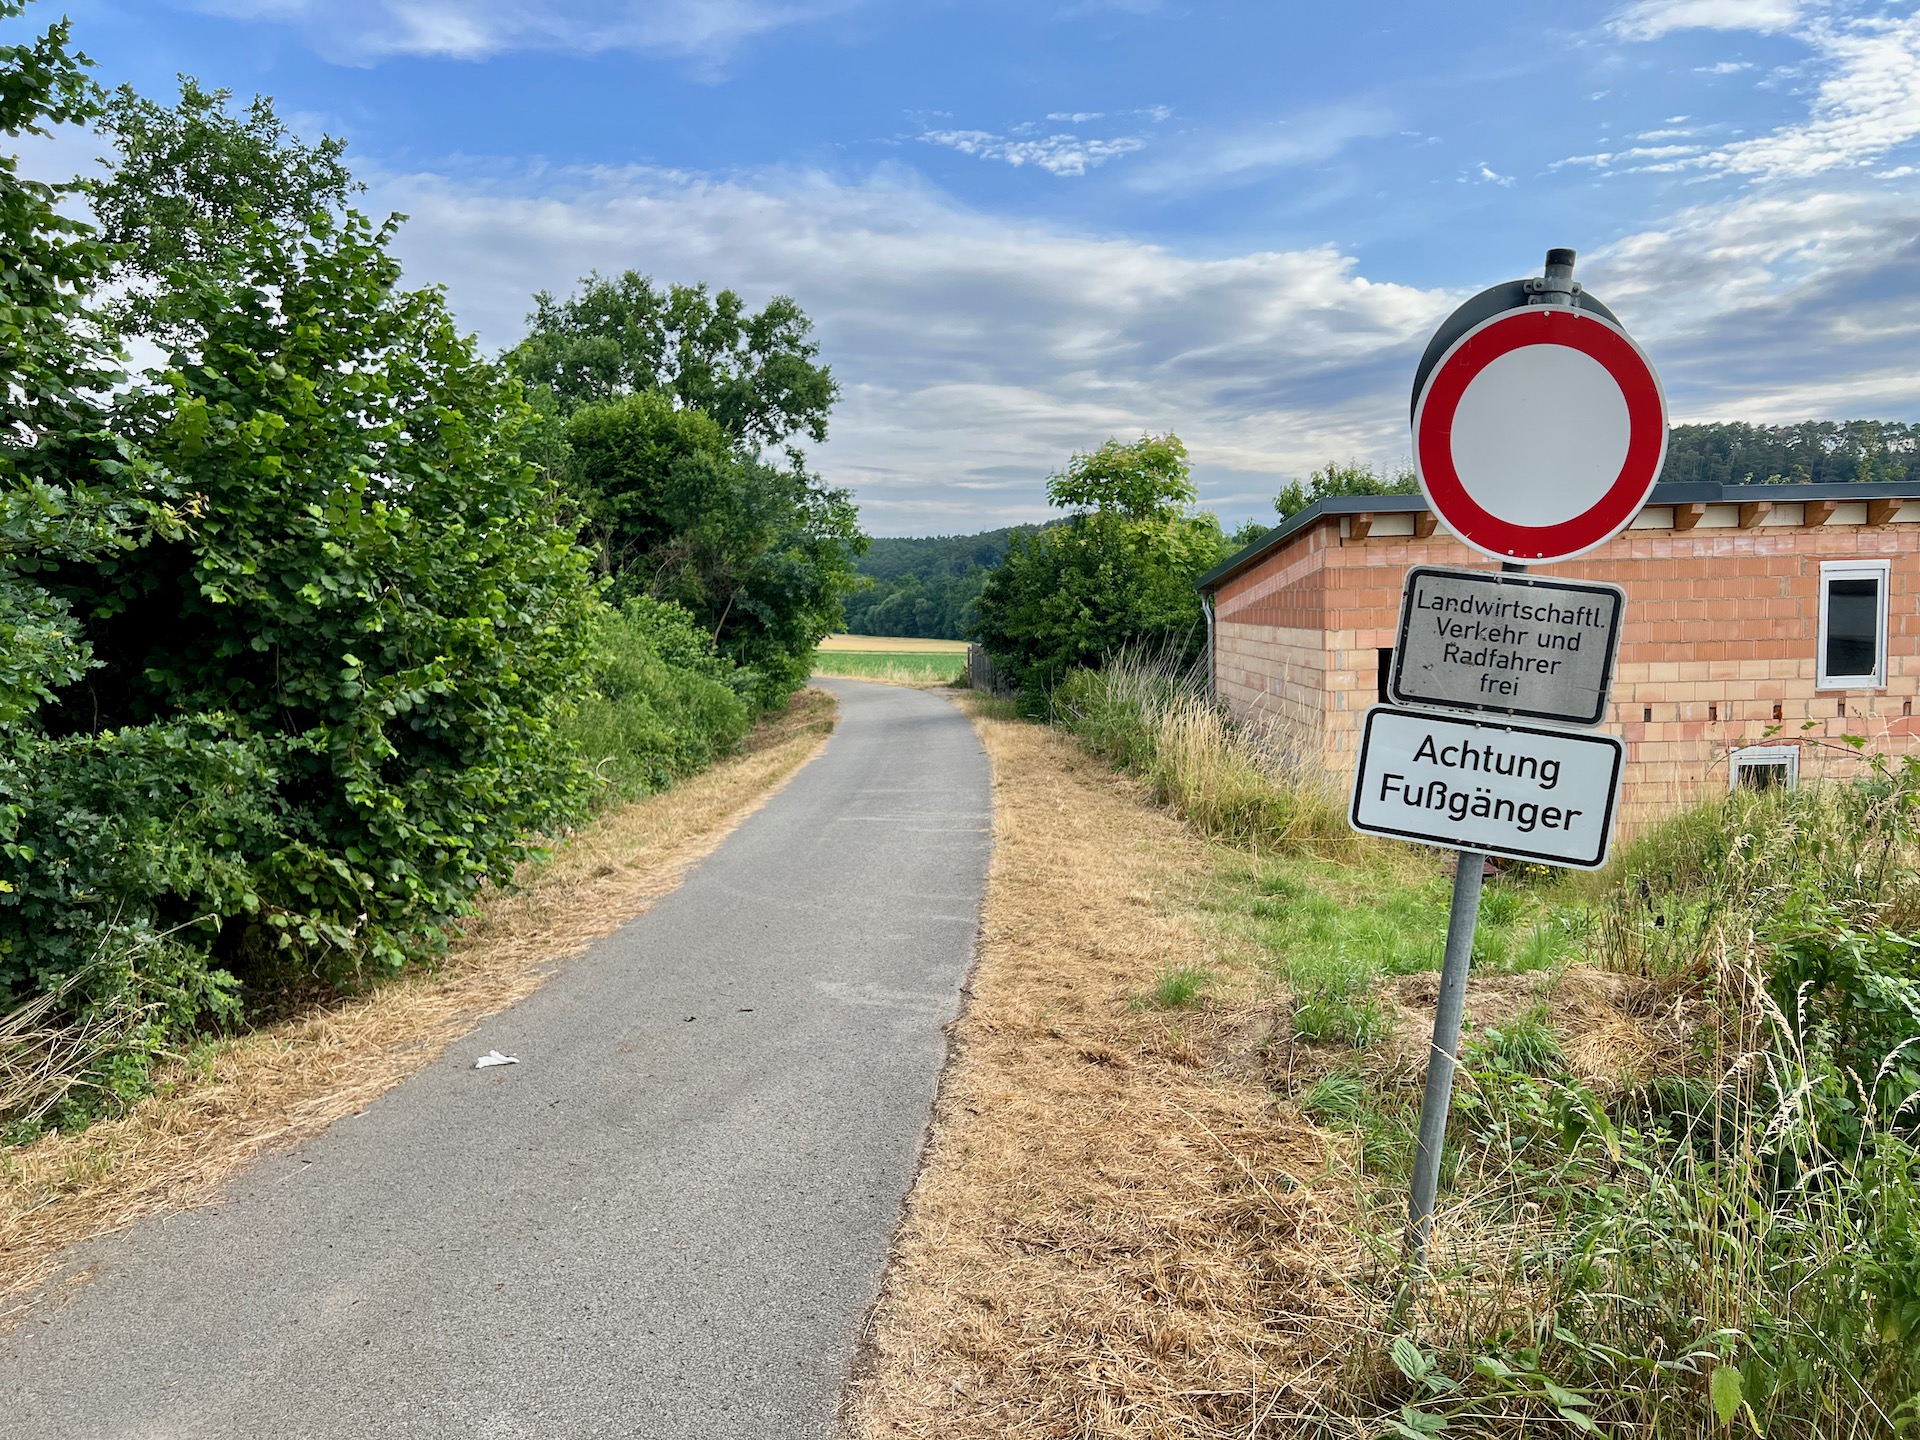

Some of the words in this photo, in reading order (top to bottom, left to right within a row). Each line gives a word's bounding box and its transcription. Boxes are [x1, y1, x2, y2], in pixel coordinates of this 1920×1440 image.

[1417, 589, 1605, 628] Landwirtschaftl.
[1436, 617, 1528, 646] Verkehr
[1537, 632, 1581, 652] und
[1443, 643, 1562, 675] Radfahrer
[1479, 673, 1519, 696] frei
[1412, 734, 1561, 790] Achtung
[1379, 773, 1583, 833] Fußgänger
